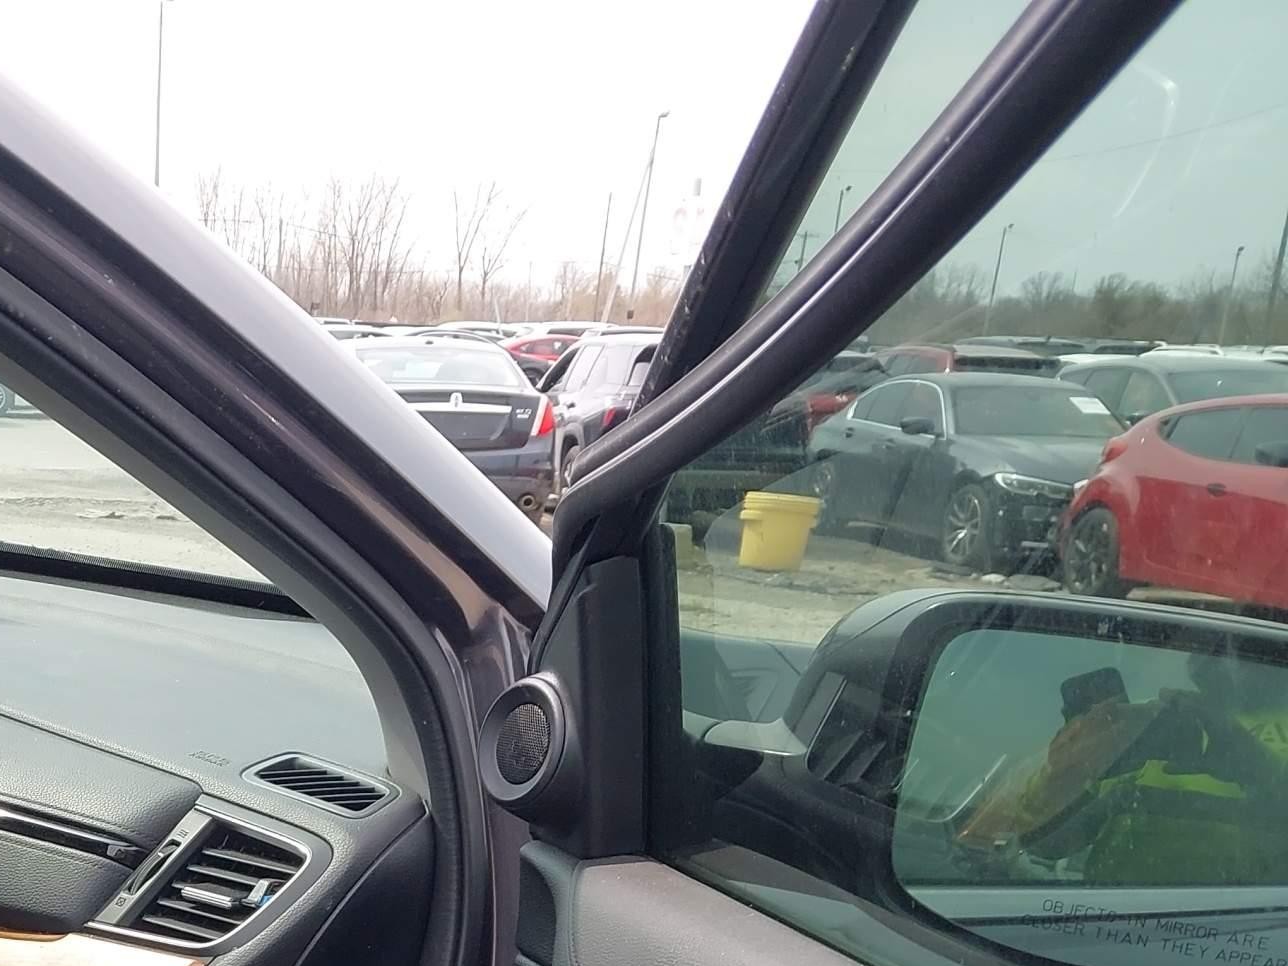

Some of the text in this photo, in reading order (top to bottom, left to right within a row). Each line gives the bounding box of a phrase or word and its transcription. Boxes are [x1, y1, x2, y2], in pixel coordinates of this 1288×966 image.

[1022, 914, 1086, 936] CLOSER
[1095, 925, 1150, 948] THAN
[1161, 938, 1209, 960] THEY
[1042, 899, 1271, 952] OBJECTS IN MIRROR ARE
